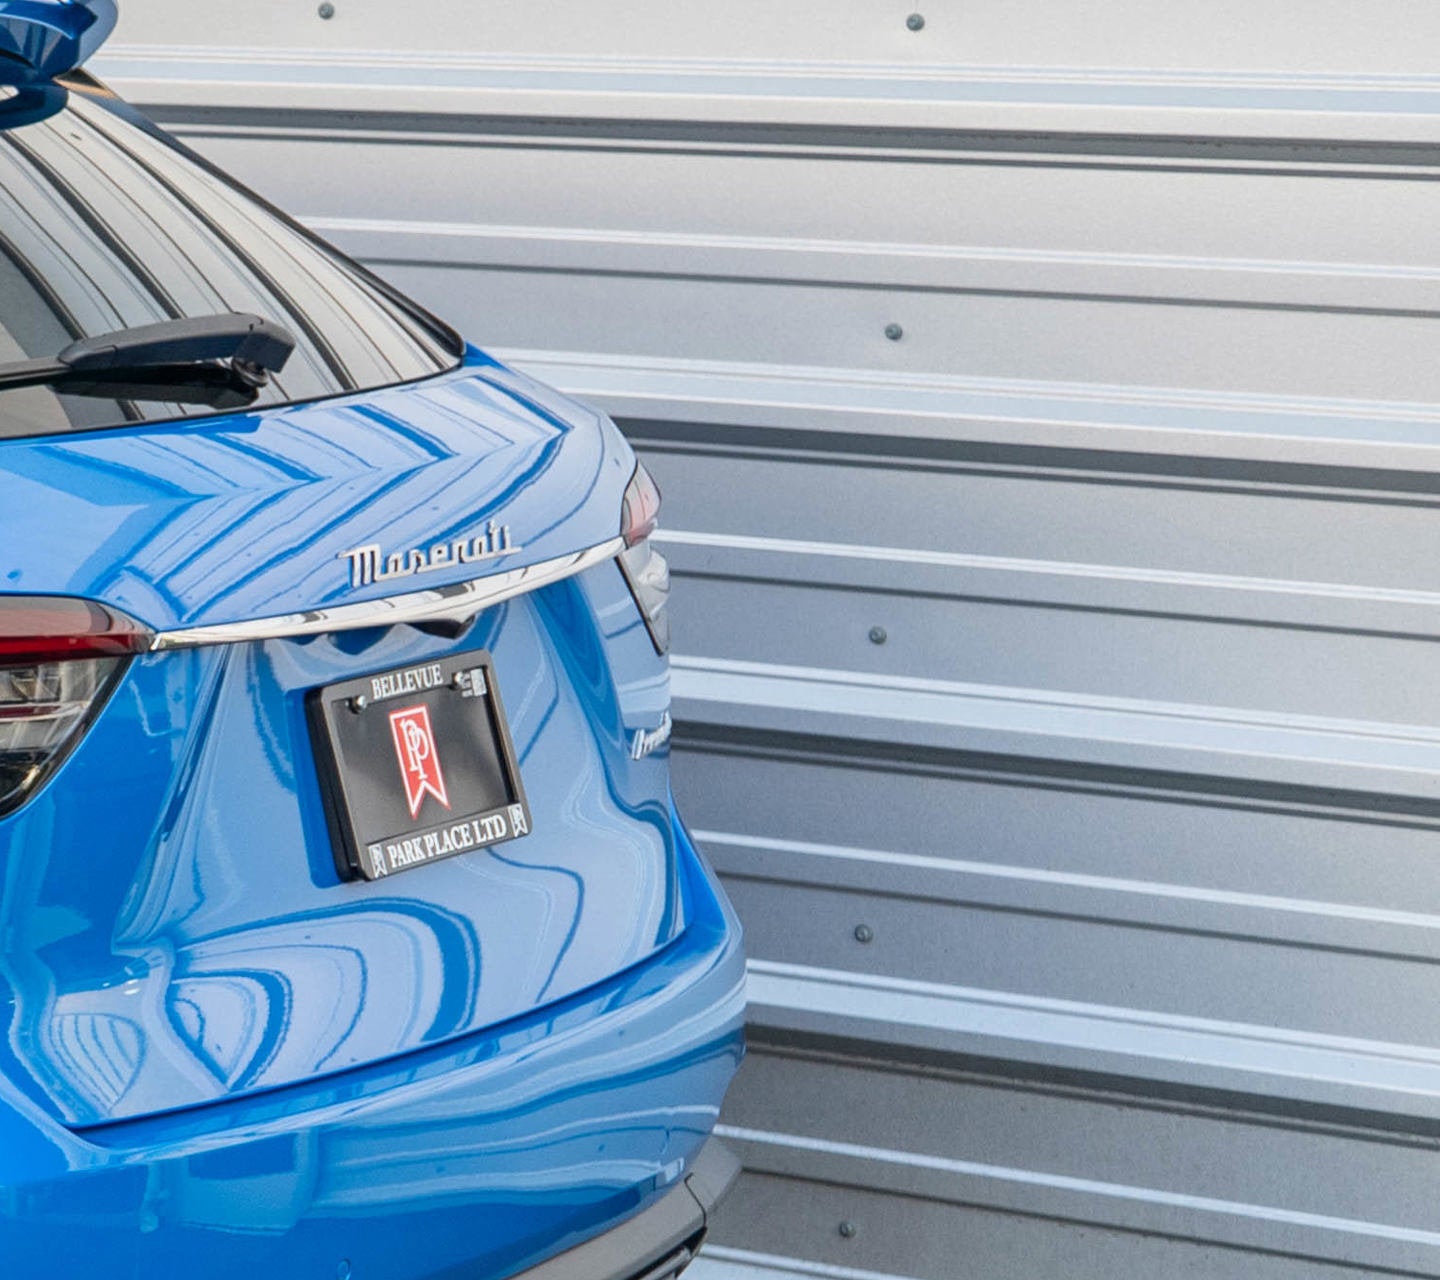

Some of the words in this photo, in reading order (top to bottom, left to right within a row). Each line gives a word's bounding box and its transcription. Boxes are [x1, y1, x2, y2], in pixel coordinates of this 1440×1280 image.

[338, 519, 522, 589] Maserati
[371, 664, 444, 701] BELLEVUE
[386, 835, 427, 869] PARK
[423, 822, 474, 858] PLACE
[471, 814, 507, 844] LTD
